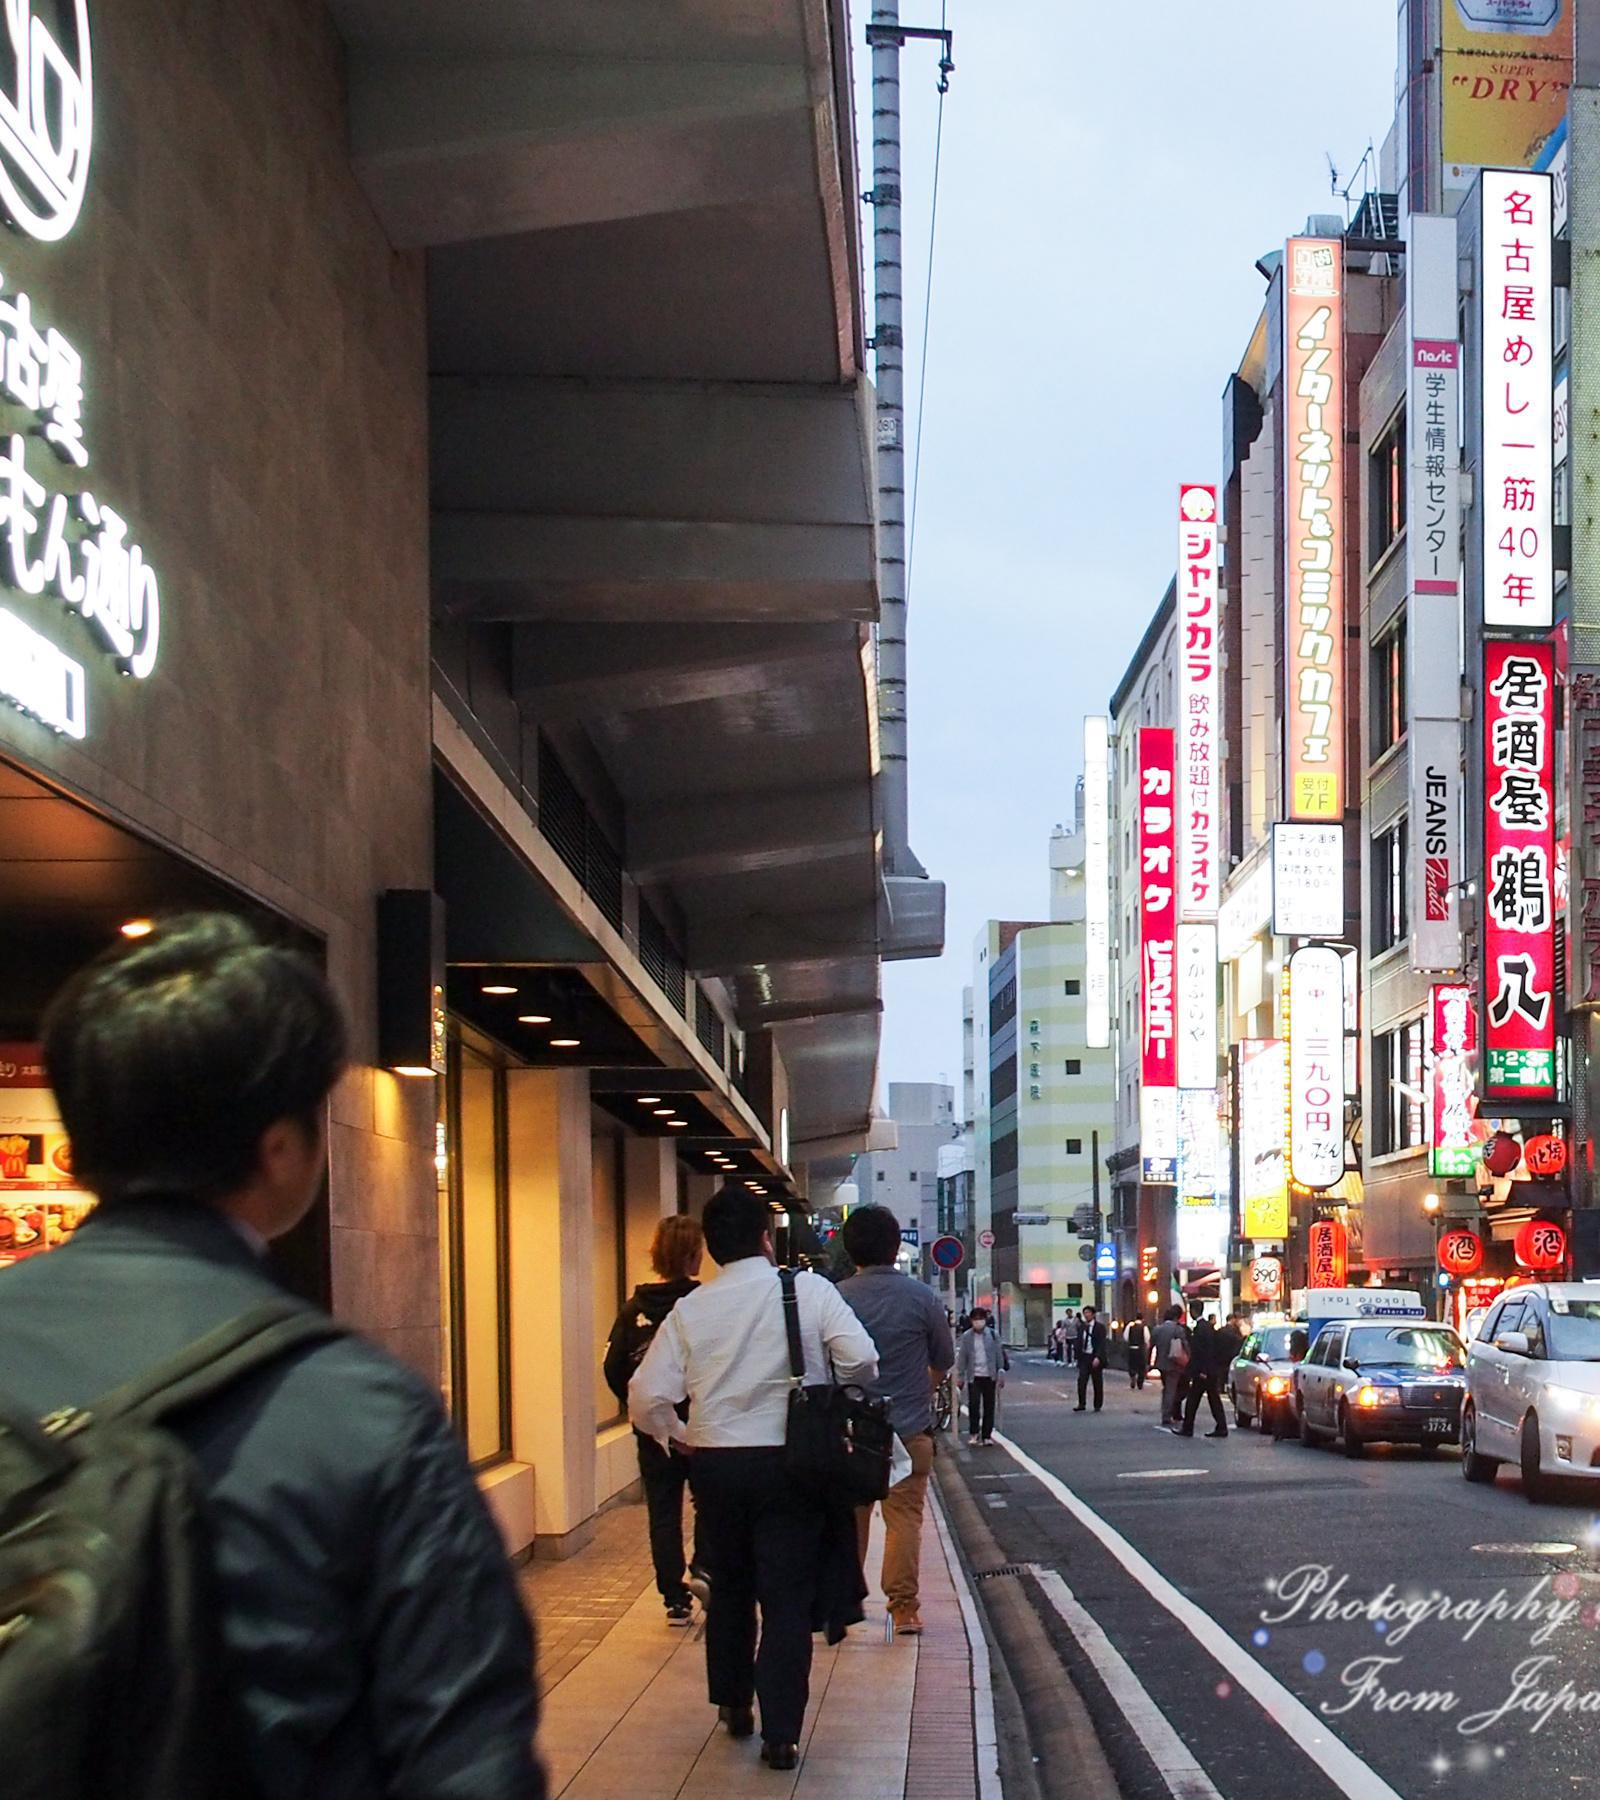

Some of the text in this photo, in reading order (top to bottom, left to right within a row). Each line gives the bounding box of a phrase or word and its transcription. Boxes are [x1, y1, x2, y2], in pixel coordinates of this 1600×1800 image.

[1491, 63, 1535, 76] SUPER
[1498, 190, 1539, 608] 名古屋めし一筋40年
[1425, 372, 1446, 576] 学生情報センター
[1186, 531, 1212, 682] ジャンカラ
[1302, 777, 1329, 791] 受付
[1493, 658, 1547, 829] 居酒屋
[1142, 766, 1172, 912] カラオケ
[1303, 792, 1329, 811] 7F
[1425, 765, 1447, 856] JEANS
[1448, 1235, 1477, 1261] 酒
[1533, 1229, 1562, 1258] 酒
